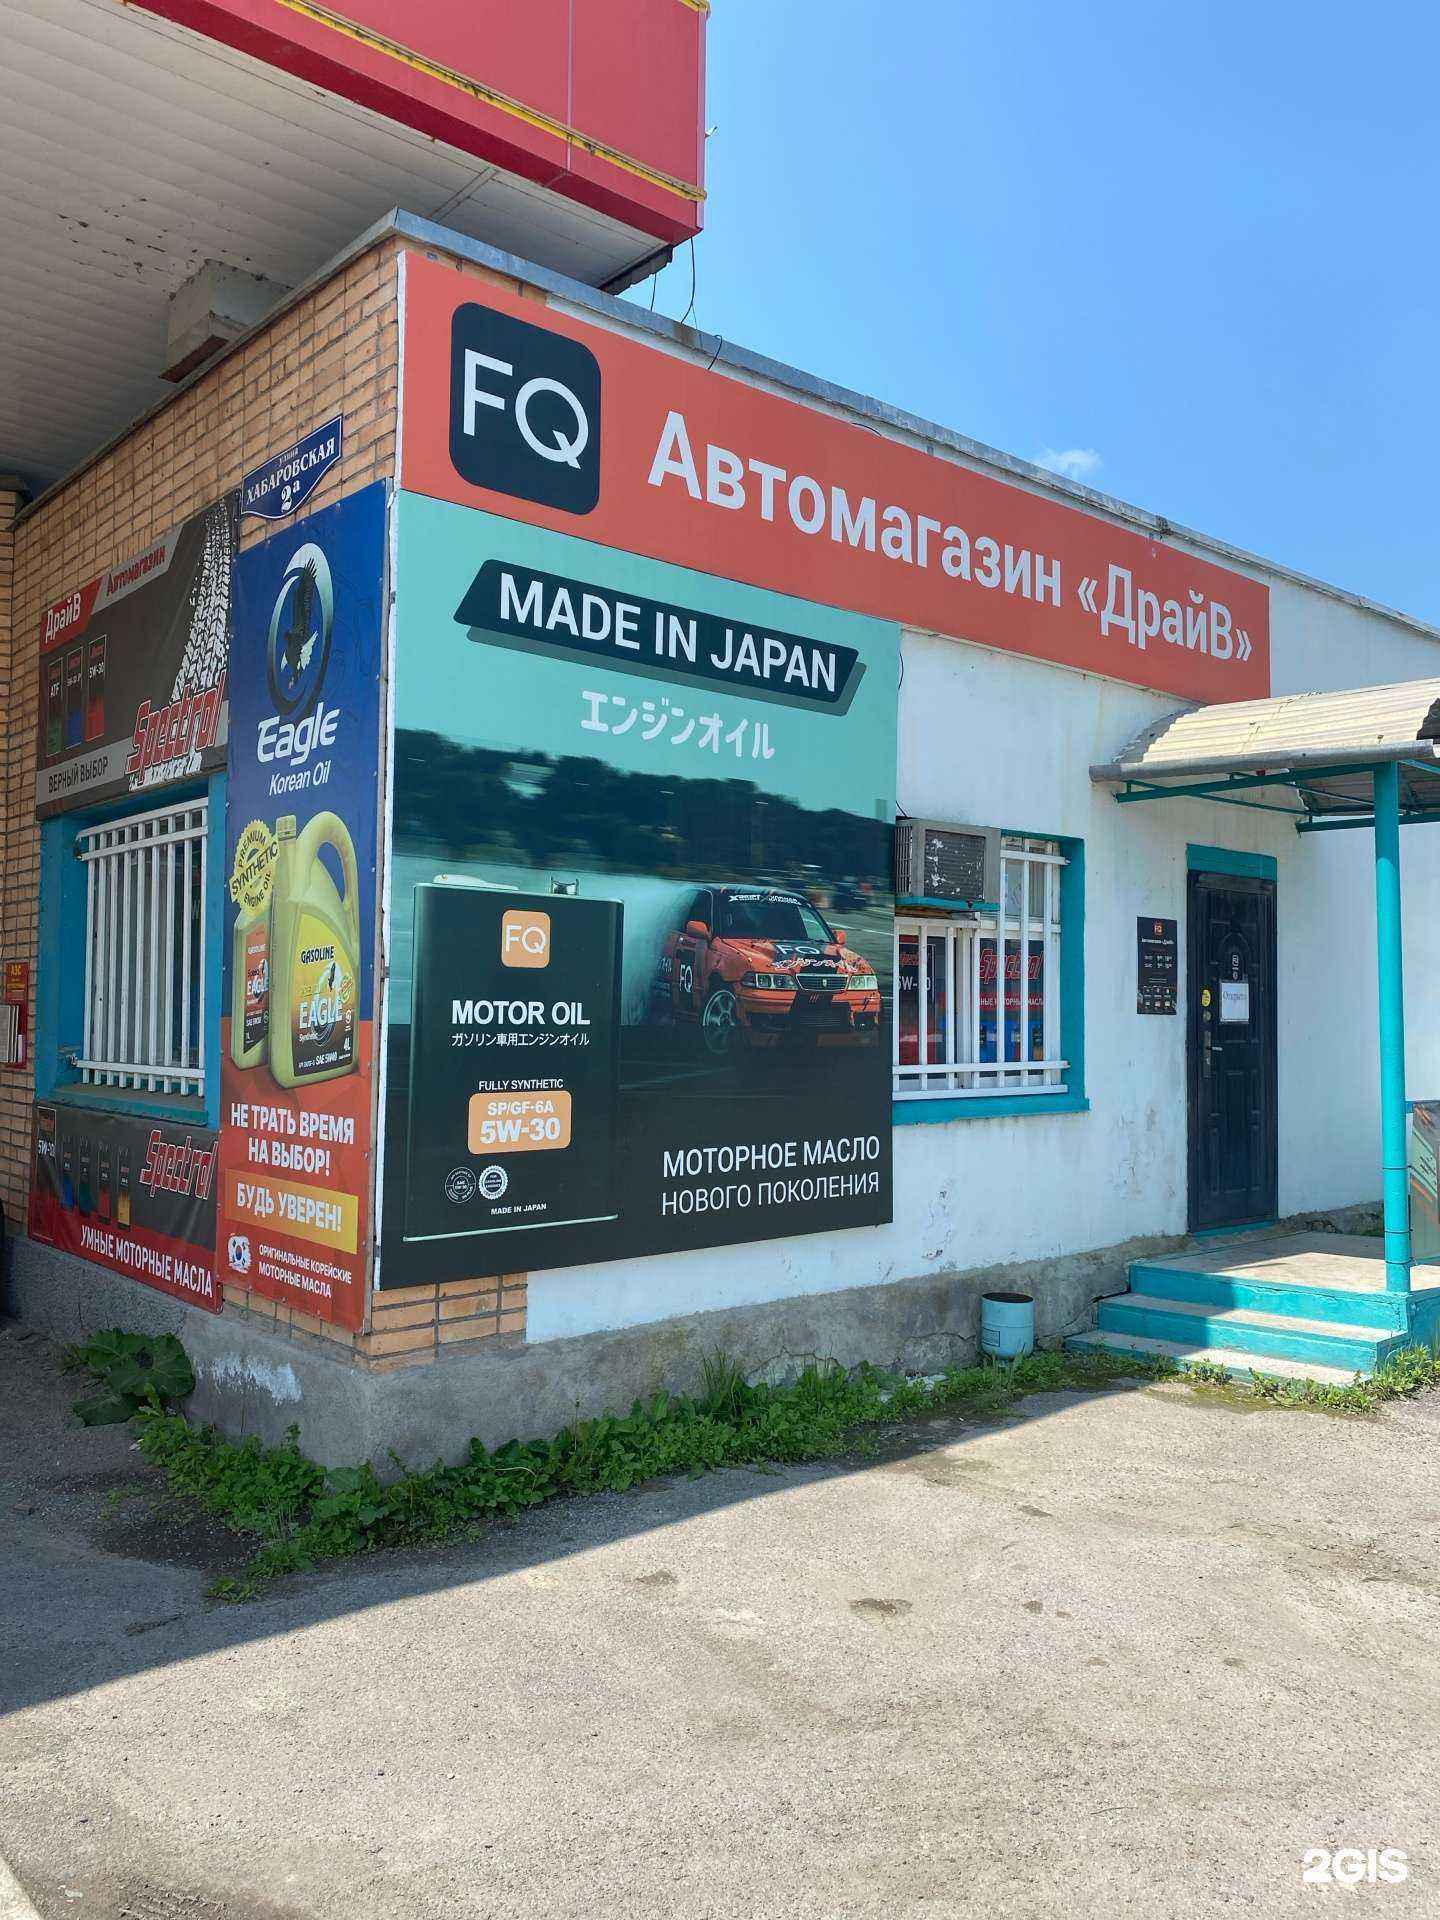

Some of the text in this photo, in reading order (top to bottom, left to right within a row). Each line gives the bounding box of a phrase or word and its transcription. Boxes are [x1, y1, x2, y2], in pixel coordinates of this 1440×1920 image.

[463, 348, 589, 470] FQ
[246, 437, 335, 505] ХАБАРОВСКАЯ
[648, 410, 1061, 607] Автомагазин
[106, 547, 165, 597] Автомагазин
[500, 572, 835, 692] MADE IN JAPAN
[124, 668, 227, 786] Spectrol
[257, 702, 340, 766] Eagle
[581, 689, 775, 760] エンジンオイル
[49, 756, 109, 793] ВЕРНЫЙ ВЫБОР
[269, 760, 331, 796] Korean Oil
[231, 841, 279, 896] SYNTHETIC
[238, 829, 267, 868] PREMIUM
[243, 889, 265, 908] ENGINE
[301, 945, 335, 964] GASOLINE
[505, 924, 547, 954] FQ
[299, 995, 343, 1029] EAGLE
[452, 999, 590, 1025] MOTOR OIL
[451, 1032, 590, 1047] ガソリン車用エンジンオイル
[478, 1078, 564, 1091] FULLY SYNTHETIC
[231, 1102, 354, 1145] НЕ ТРАТЬ ВРЕМЯ
[487, 1100, 554, 1116] SP/GF-6A
[480, 1117, 561, 1144] 5W-30
[139, 1129, 219, 1200] Spectrol
[248, 1137, 331, 1177] НА ВЫБОР!
[663, 1135, 880, 1178] МОТОРНОЕ МАСЛО
[237, 1182, 342, 1233] БУДЬ УВЕРЕН!
[490, 1203, 547, 1215] MADE IN JAPAN
[662, 1171, 879, 1216] НОВОГО ПОКОЛЕНИЯ
[80, 1224, 213, 1298] УМНЫЕ МОТОРНЫЕ МАСЛА
[258, 1261, 332, 1298] МОТОРНЫЕ МАСЛА
[259, 1244, 352, 1285] ОРИГИНАЛЬНЫЕ КОРЕЙСКИЕ
